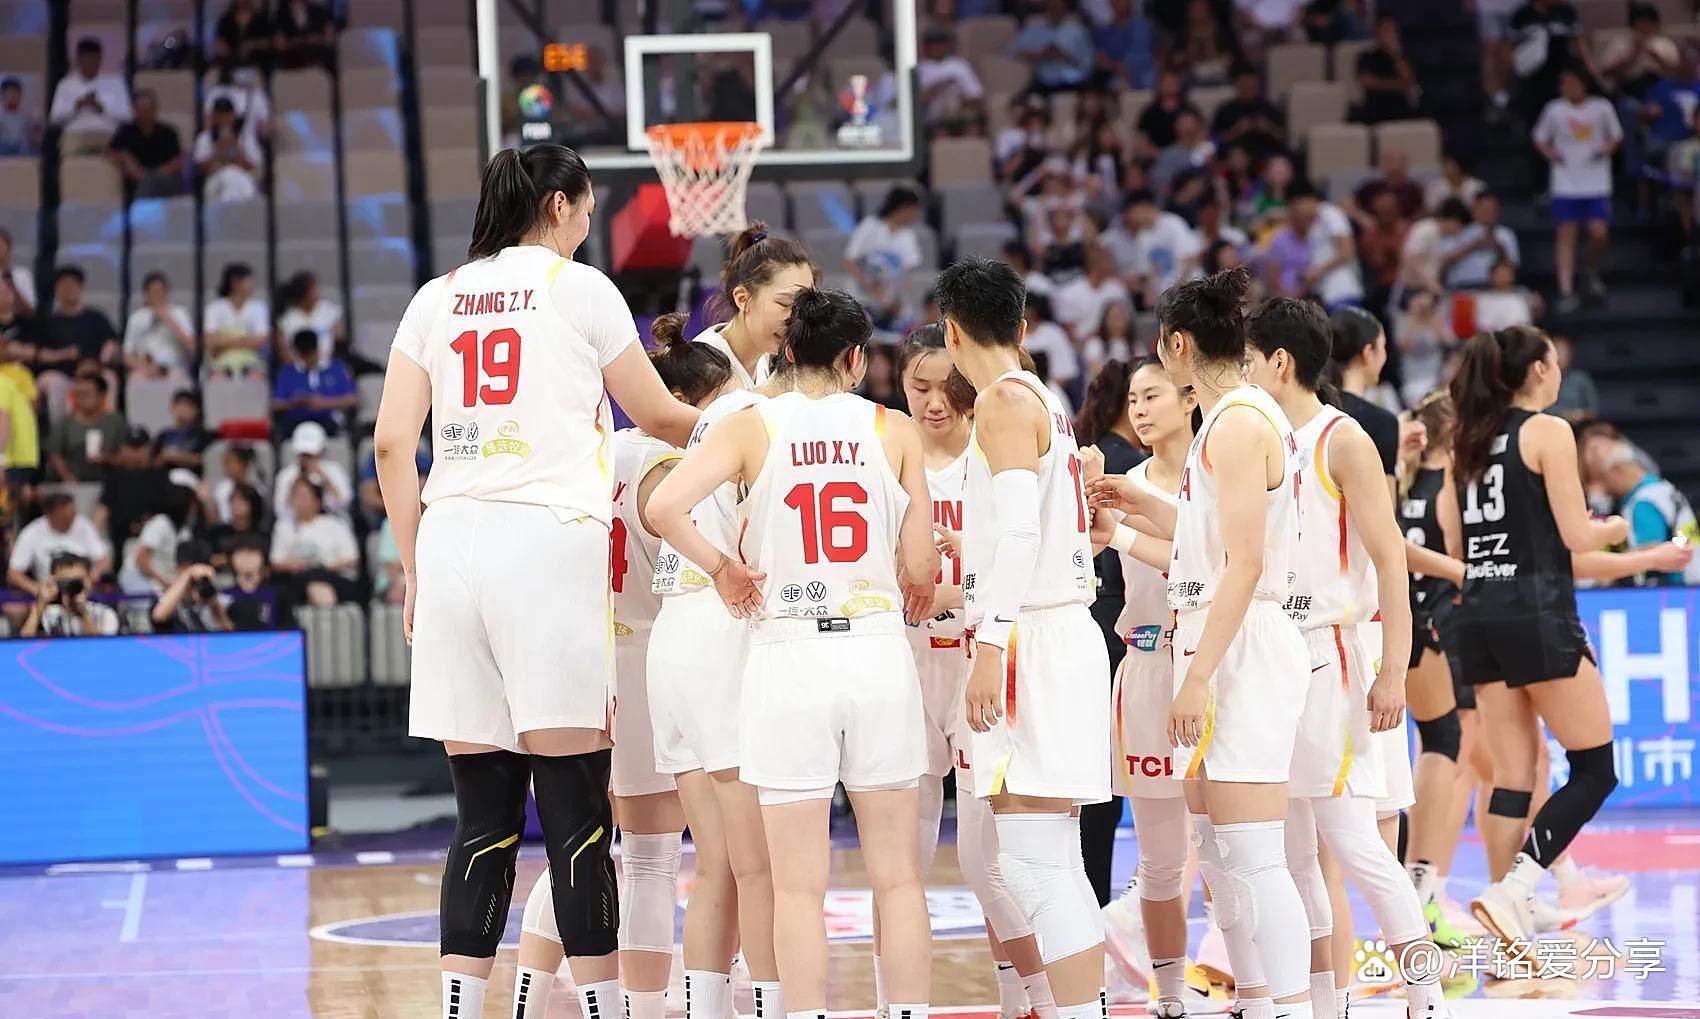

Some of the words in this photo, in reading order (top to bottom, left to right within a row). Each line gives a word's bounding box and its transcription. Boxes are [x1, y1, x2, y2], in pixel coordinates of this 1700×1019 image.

[453, 291, 505, 315] ZHANG
[508, 289, 537, 312] Z.Y.
[450, 327, 521, 407] 19
[791, 441, 827, 467] LUO
[832, 440, 865, 466] X.Y.
[784, 482, 868, 564] 16
[1463, 464, 1505, 524] 13
